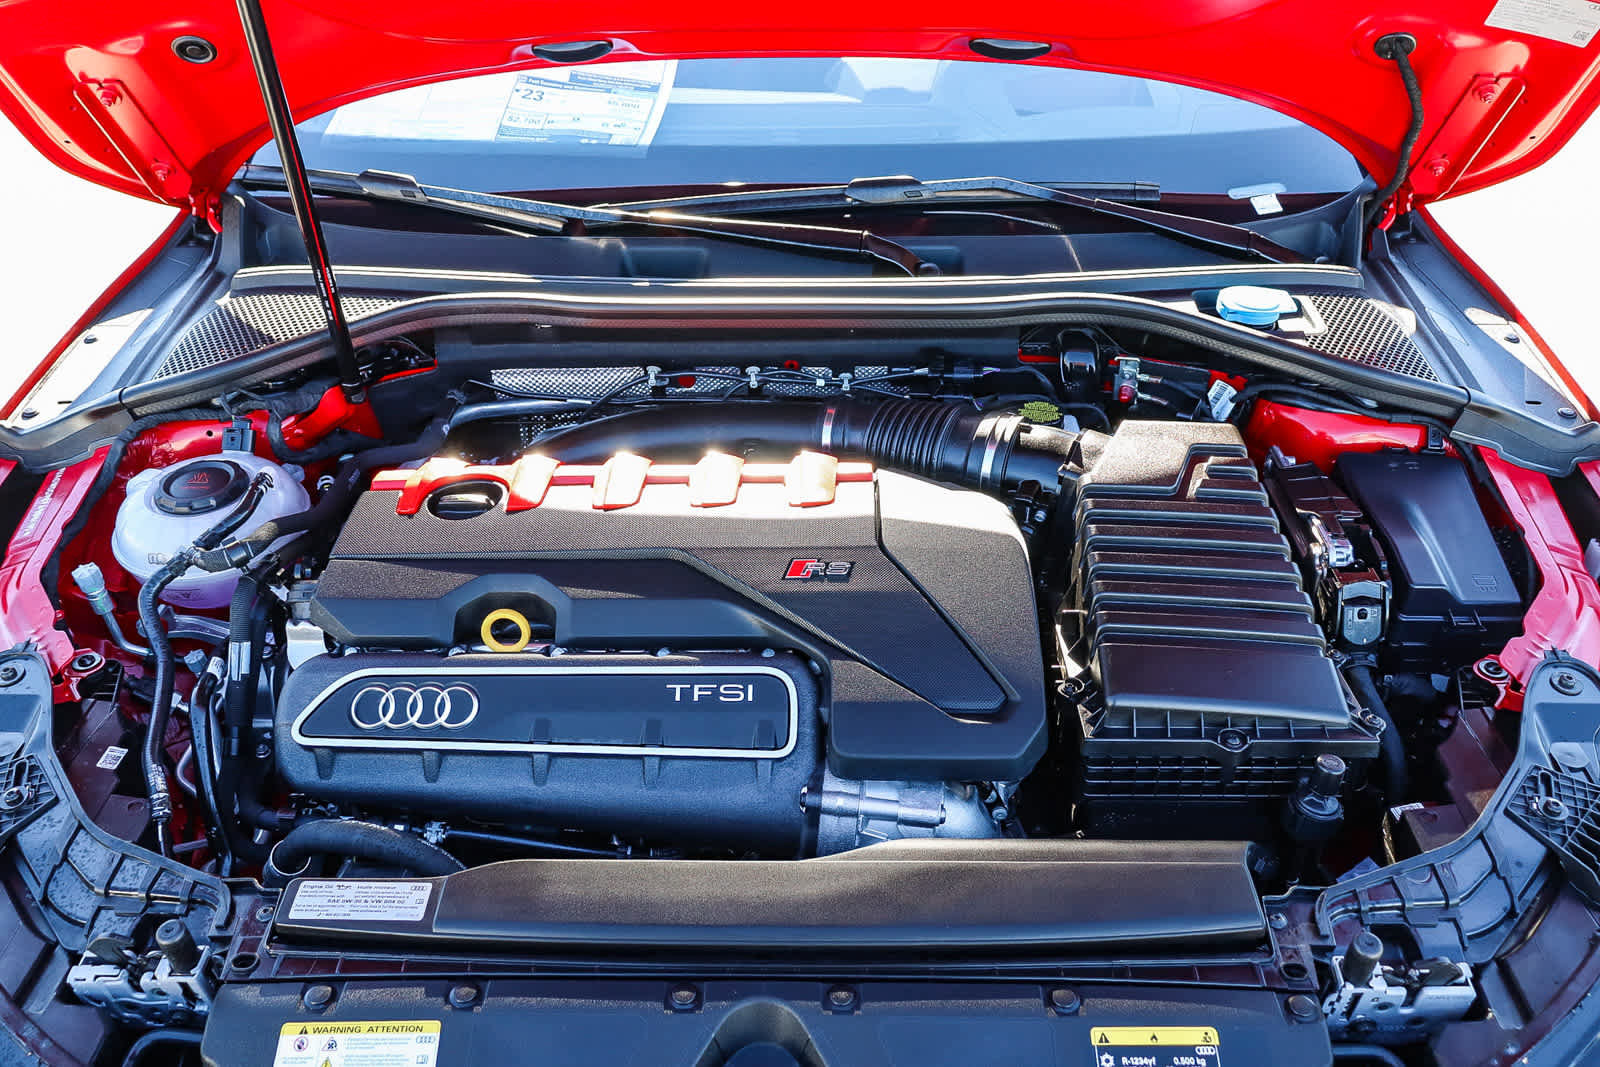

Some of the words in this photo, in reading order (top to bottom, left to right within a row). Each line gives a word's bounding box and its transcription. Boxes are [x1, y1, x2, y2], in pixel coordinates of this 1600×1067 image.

[521, 88, 545, 102] 23
[792, 559, 853, 577] RS
[666, 684, 753, 702] TFSI
[312, 1026, 362, 1034] WARNING
[367, 1025, 424, 1033] ATTENTION
[1173, 1056, 1196, 1066] 0.500
